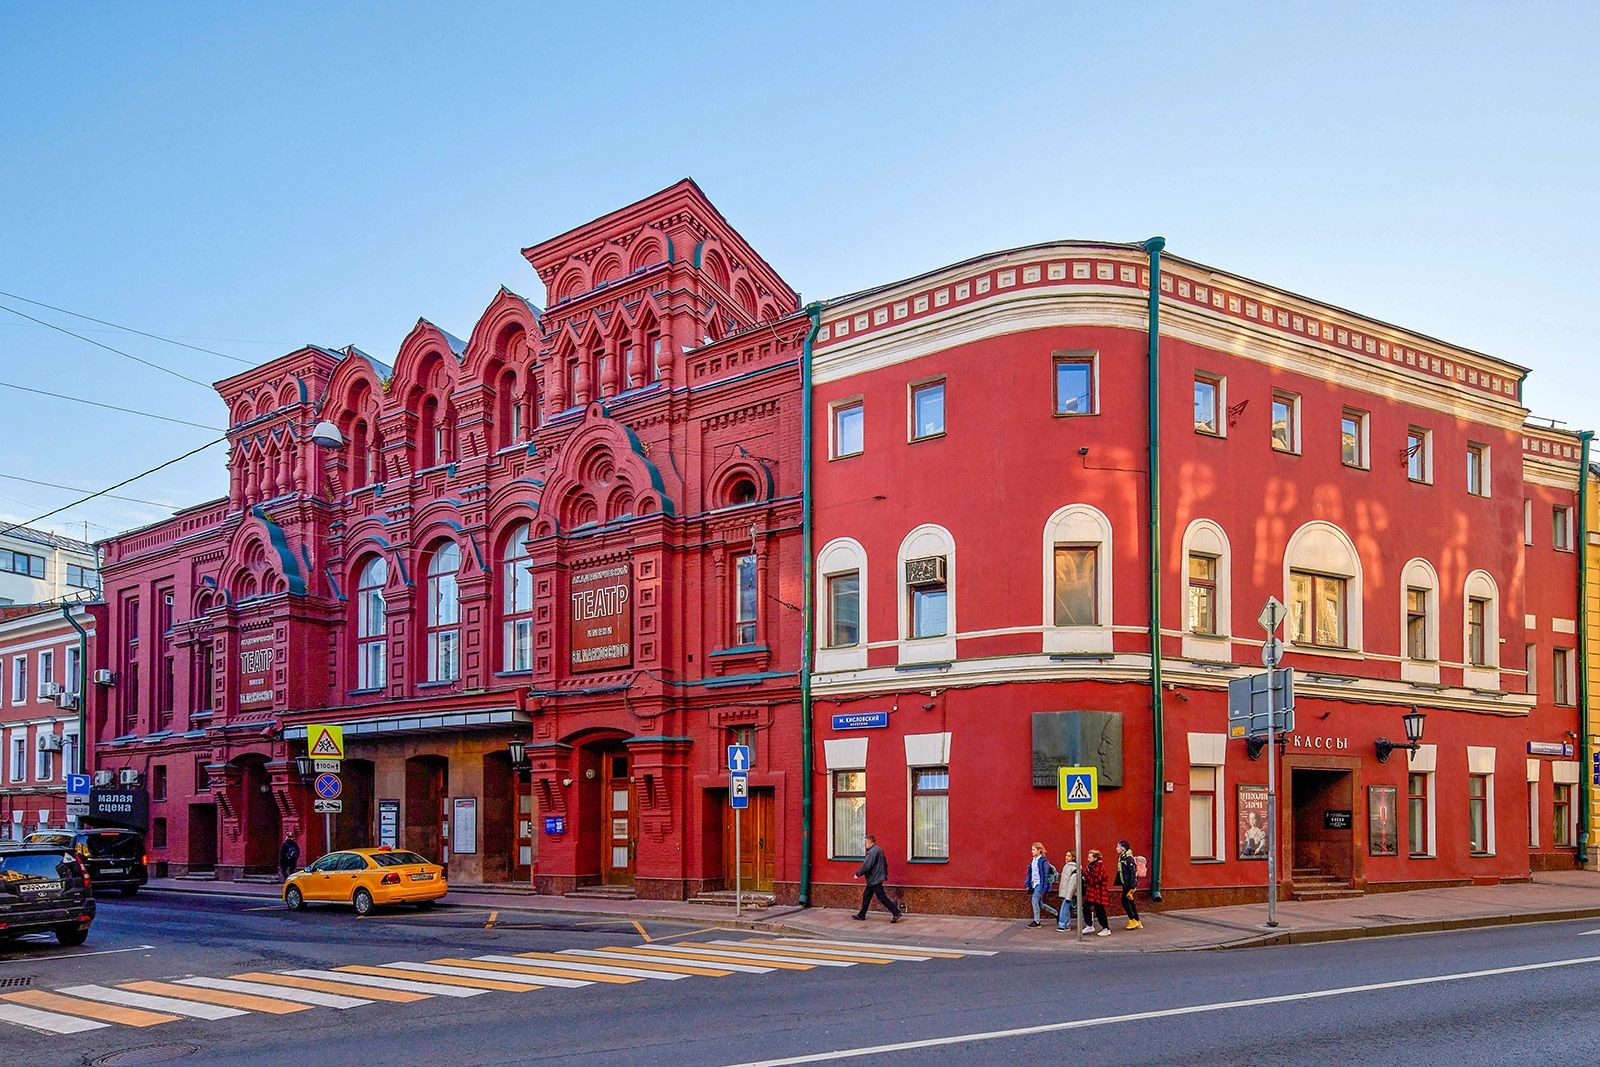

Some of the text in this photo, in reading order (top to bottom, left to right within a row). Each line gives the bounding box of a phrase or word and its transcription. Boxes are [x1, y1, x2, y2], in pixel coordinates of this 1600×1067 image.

[572, 584, 629, 621] ТЕАТР
[240, 647, 274, 674] ТЕАТР
[1294, 735, 1348, 749] КАССЫ
[73, 776, 85, 792] P
[98, 794, 133, 803] малая
[98, 803, 131, 812] сцена
